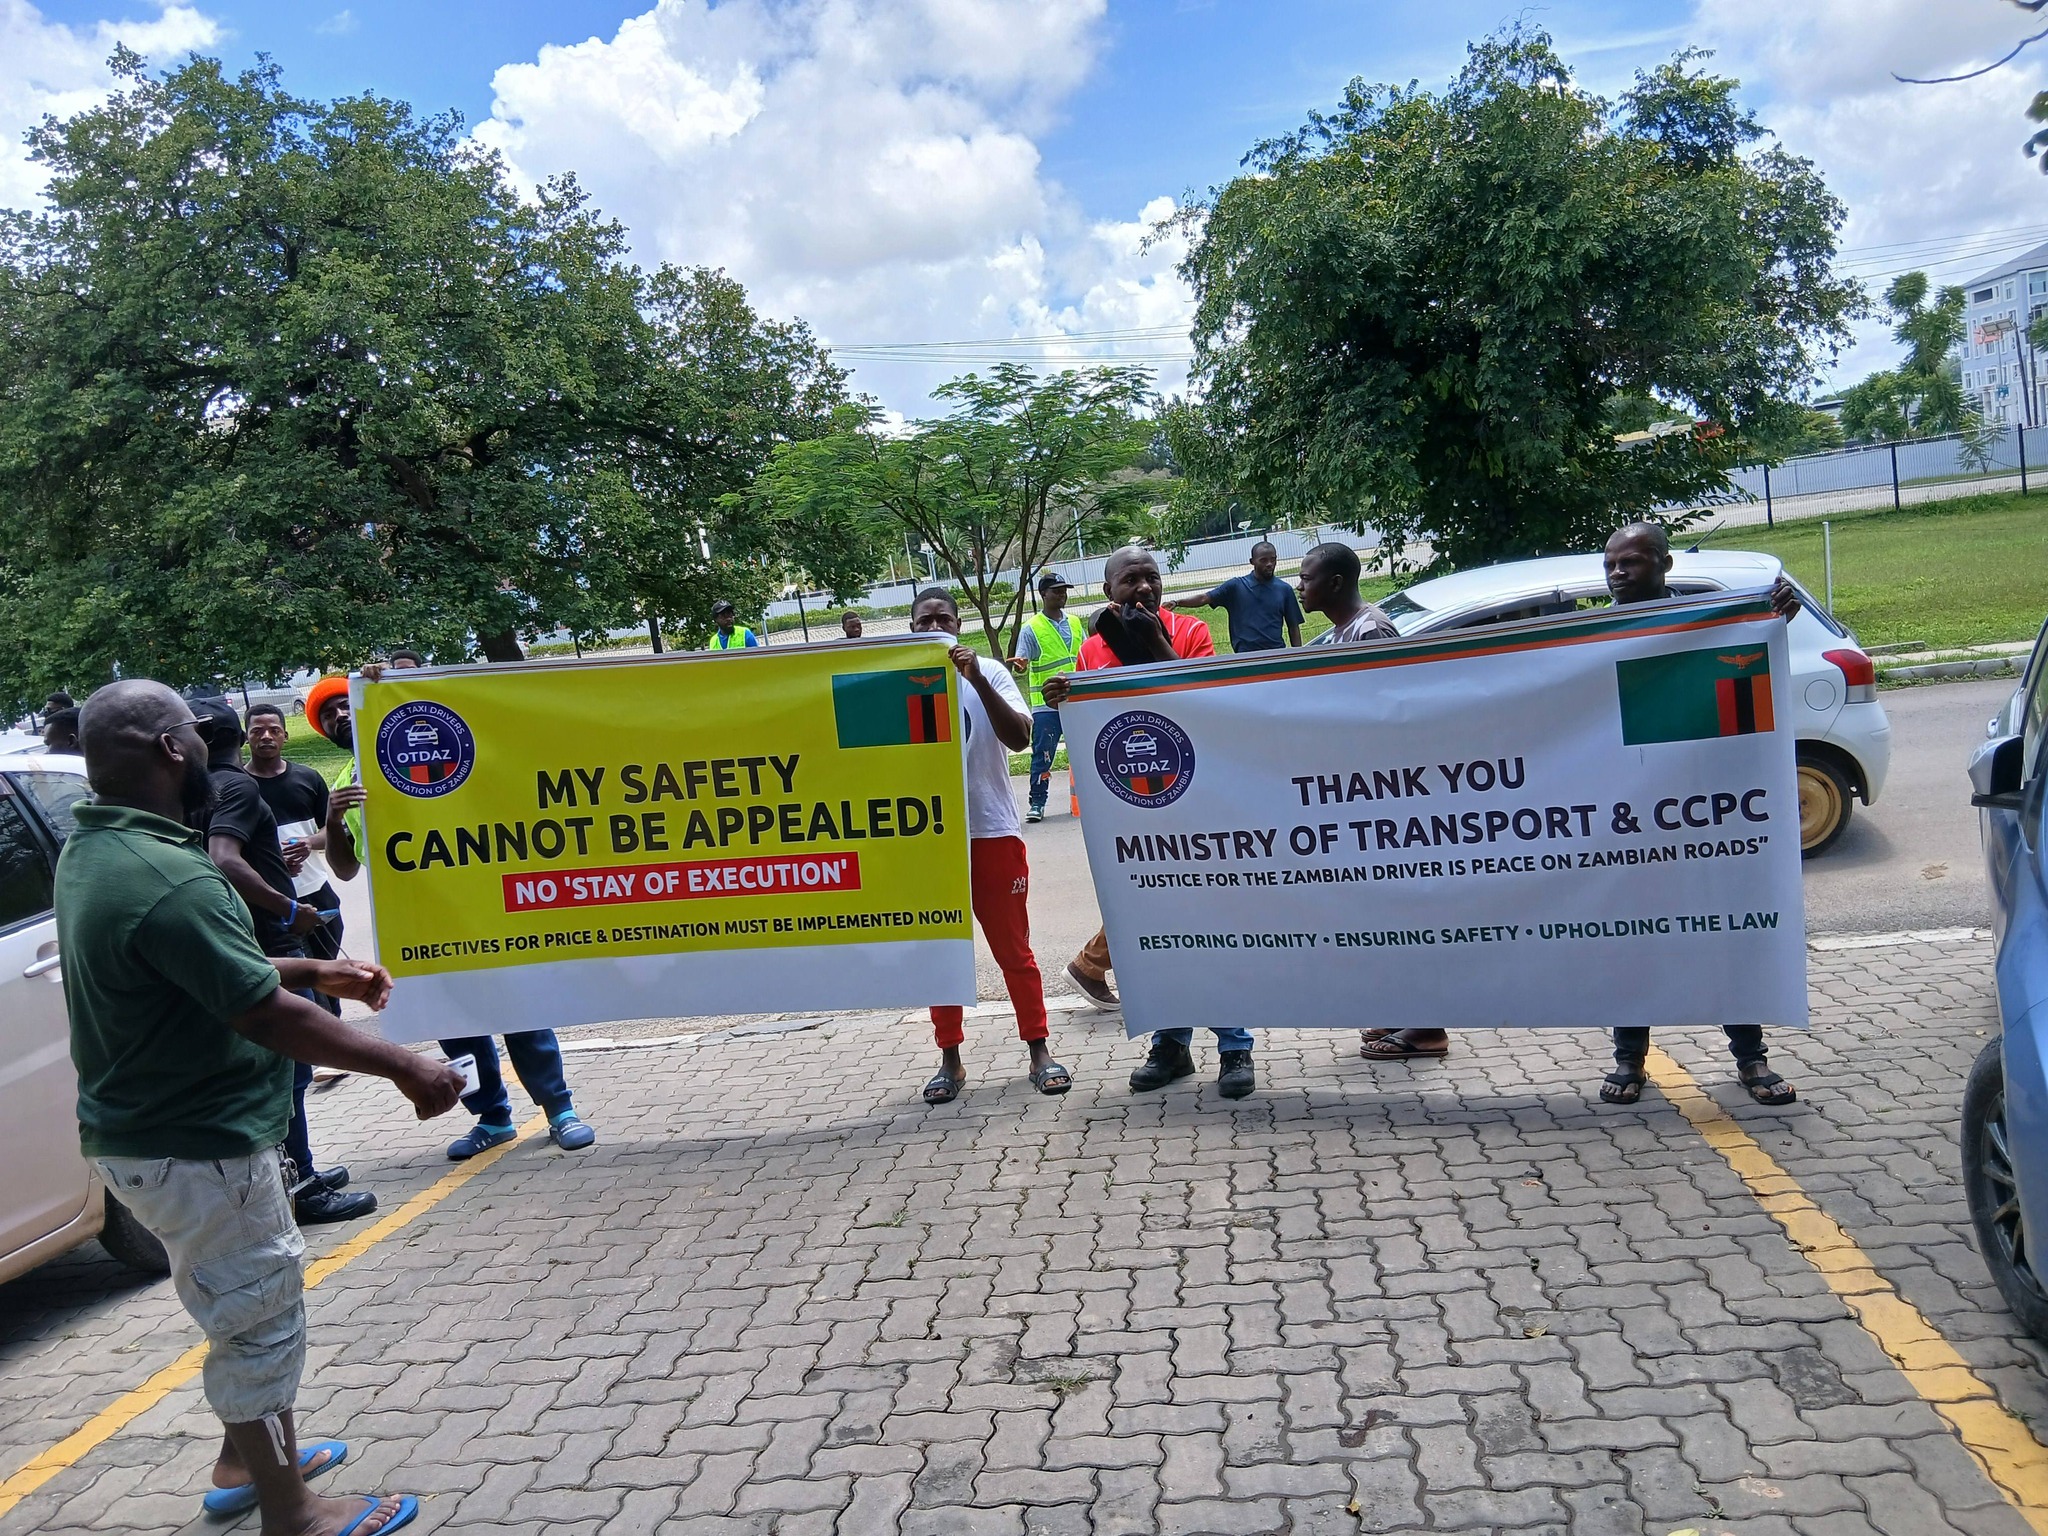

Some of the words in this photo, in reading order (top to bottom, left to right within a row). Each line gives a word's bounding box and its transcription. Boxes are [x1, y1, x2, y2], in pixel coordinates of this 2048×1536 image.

[381, 709, 406, 738] ONLINE
[406, 705, 427, 714] TAXI
[430, 706, 465, 735] DRIVERS
[1099, 720, 1124, 749] ONLINE
[1124, 715, 1145, 724] TAXI
[1147, 716, 1184, 744] DRIVERS
[397, 749, 451, 763] OTDAZ
[1117, 760, 1170, 774] OTDAZ
[382, 763, 432, 794] ASSOCIATION
[435, 784, 447, 793] OF
[448, 760, 471, 788] ZAMBIA
[537, 767, 605, 809] MY
[620, 754, 800, 804] SAFETY
[1103, 773, 1153, 806] ASSOCIATION
[1155, 796, 1167, 805] OF
[1167, 770, 1190, 800] ZAMBIA
[1291, 766, 1430, 806] THANK
[1438, 757, 1525, 793] YOU
[385, 816, 594, 872] CANNOT
[609, 812, 669, 853] BE
[682, 795, 944, 849] APPEALED!
[1115, 828, 1277, 863] MINISTRY
[1289, 823, 1338, 856] OF
[1349, 804, 1597, 851] TRANSPORT
[1611, 802, 1642, 834] &
[1653, 789, 1770, 830] CCPC
[515, 881, 557, 904] NO
[564, 873, 636, 900] 'STAY
[644, 871, 680, 894] OF
[687, 859, 847, 892] EXECUTION'
[1130, 873, 1201, 888] “JUSTICE
[1206, 873, 1240, 887] FOR
[1242, 871, 1278, 886] THE
[1282, 866, 1367, 884] ZAMBIAN
[1372, 861, 1444, 880] DRIVER
[1449, 860, 1466, 876] IS
[1472, 856, 1535, 875] PEACE
[1541, 854, 1572, 871] ON
[1577, 845, 1677, 868] ZAMBIAN
[1684, 836, 1769, 860] ROADS”
[401, 939, 500, 962] DIRECTIVES
[505, 935, 540, 952] FOR
[544, 930, 592, 950] PRICE
[596, 929, 609, 944] &
[612, 921, 720, 942] DESTINATION
[724, 918, 768, 935] MUST
[773, 917, 794, 932] BE
[798, 911, 914, 931] IMPLEMENTED
[918, 909, 963, 925] NOW!
[1139, 934, 1238, 950] RESTORING
[1243, 933, 1317, 949] DIGNITY
[1334, 929, 1435, 947] ENSURING
[1440, 925, 1519, 944] SAFETY
[1539, 917, 1670, 939] UPHOLDING
[1676, 914, 1721, 932] THE
[1728, 912, 1779, 930] LAW
